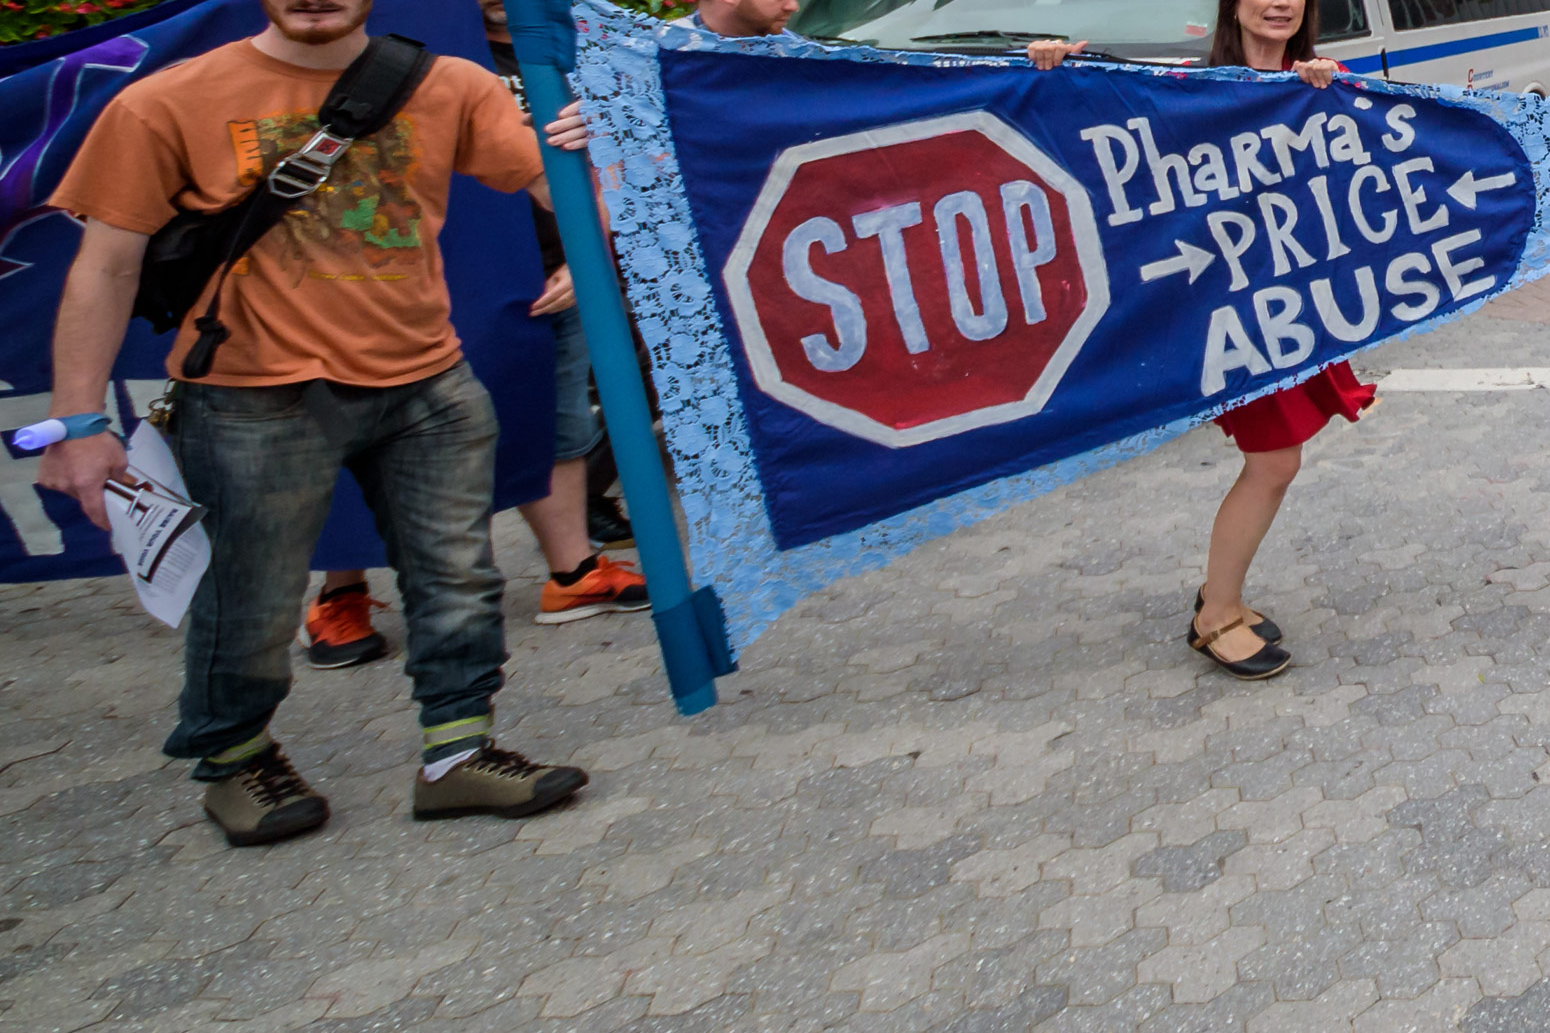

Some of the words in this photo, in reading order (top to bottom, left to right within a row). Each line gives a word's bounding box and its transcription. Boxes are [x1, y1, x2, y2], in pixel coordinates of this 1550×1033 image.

[781, 179, 1057, 373] STOP
[1207, 156, 1450, 293] PRICE
[1200, 228, 1496, 397] ABUSE
